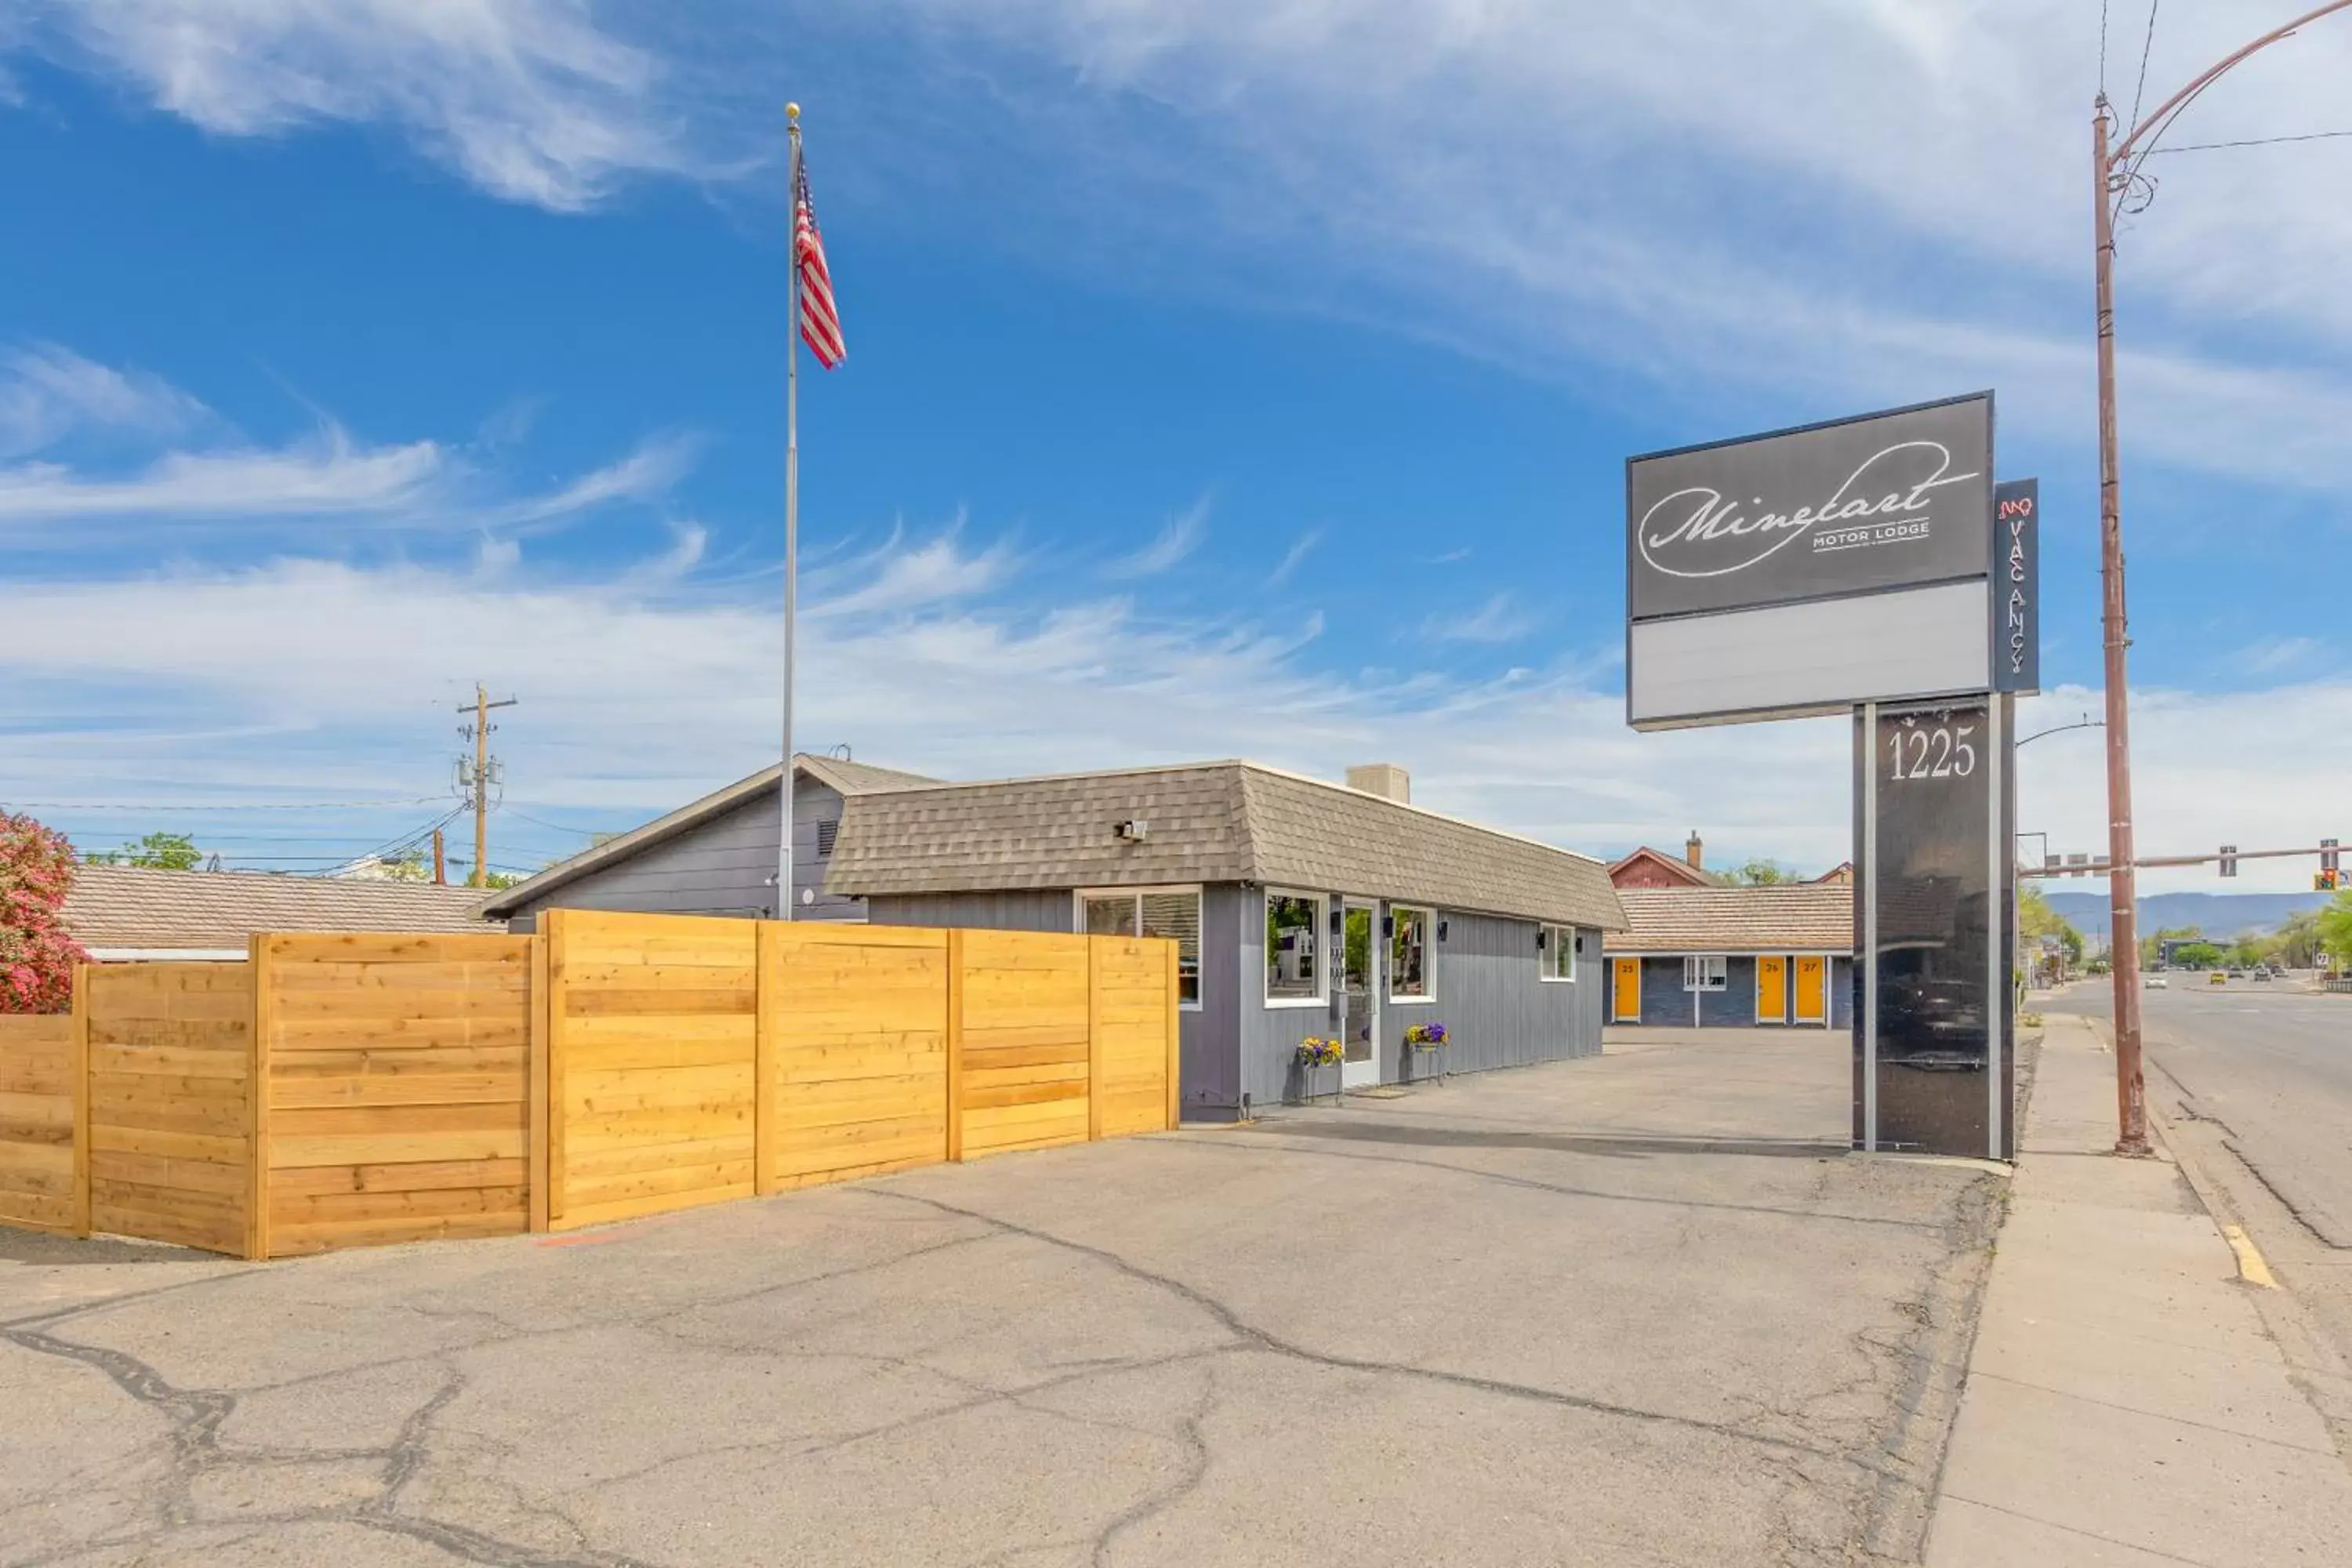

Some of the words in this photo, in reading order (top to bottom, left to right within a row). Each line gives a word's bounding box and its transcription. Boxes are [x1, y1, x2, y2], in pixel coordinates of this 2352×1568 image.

[1998, 498, 2033, 520] NO
[1813, 531, 1869, 548] MOTOR
[1876, 522, 1929, 539] LODGE
[2009, 520, 2026, 673] VACANCY
[1889, 726, 1975, 780] 1225
[1804, 963, 1817, 973] 27
